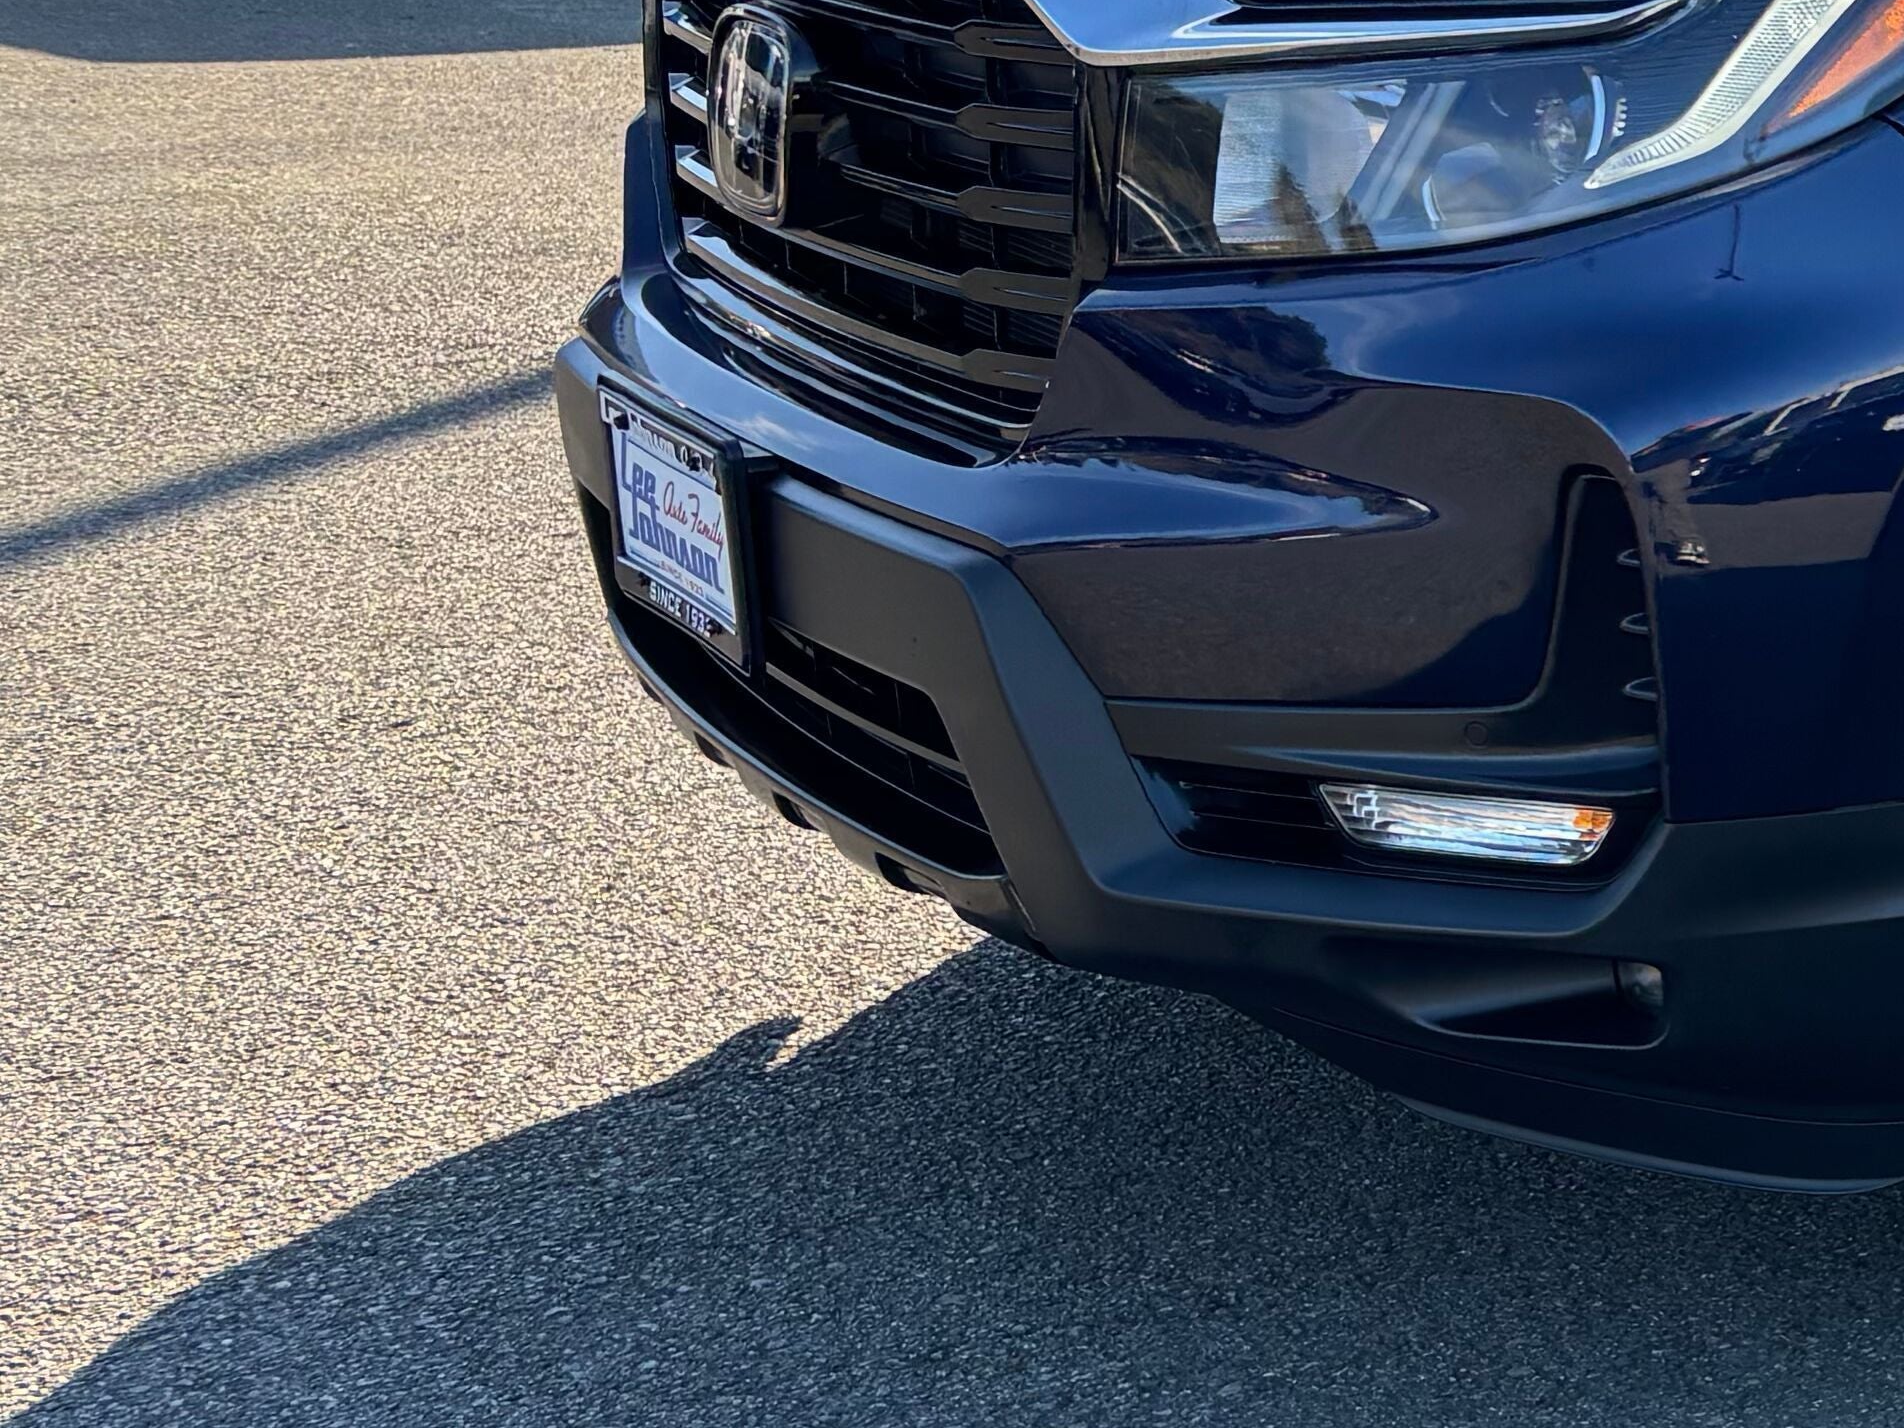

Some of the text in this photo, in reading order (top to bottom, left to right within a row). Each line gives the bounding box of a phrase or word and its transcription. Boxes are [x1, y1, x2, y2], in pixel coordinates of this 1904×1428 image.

[621, 432, 660, 510] Lee
[663, 480, 688, 525] Auto
[688, 492, 726, 559] Family
[629, 490, 725, 595] Johnson
[649, 580, 682, 618] SINCE
